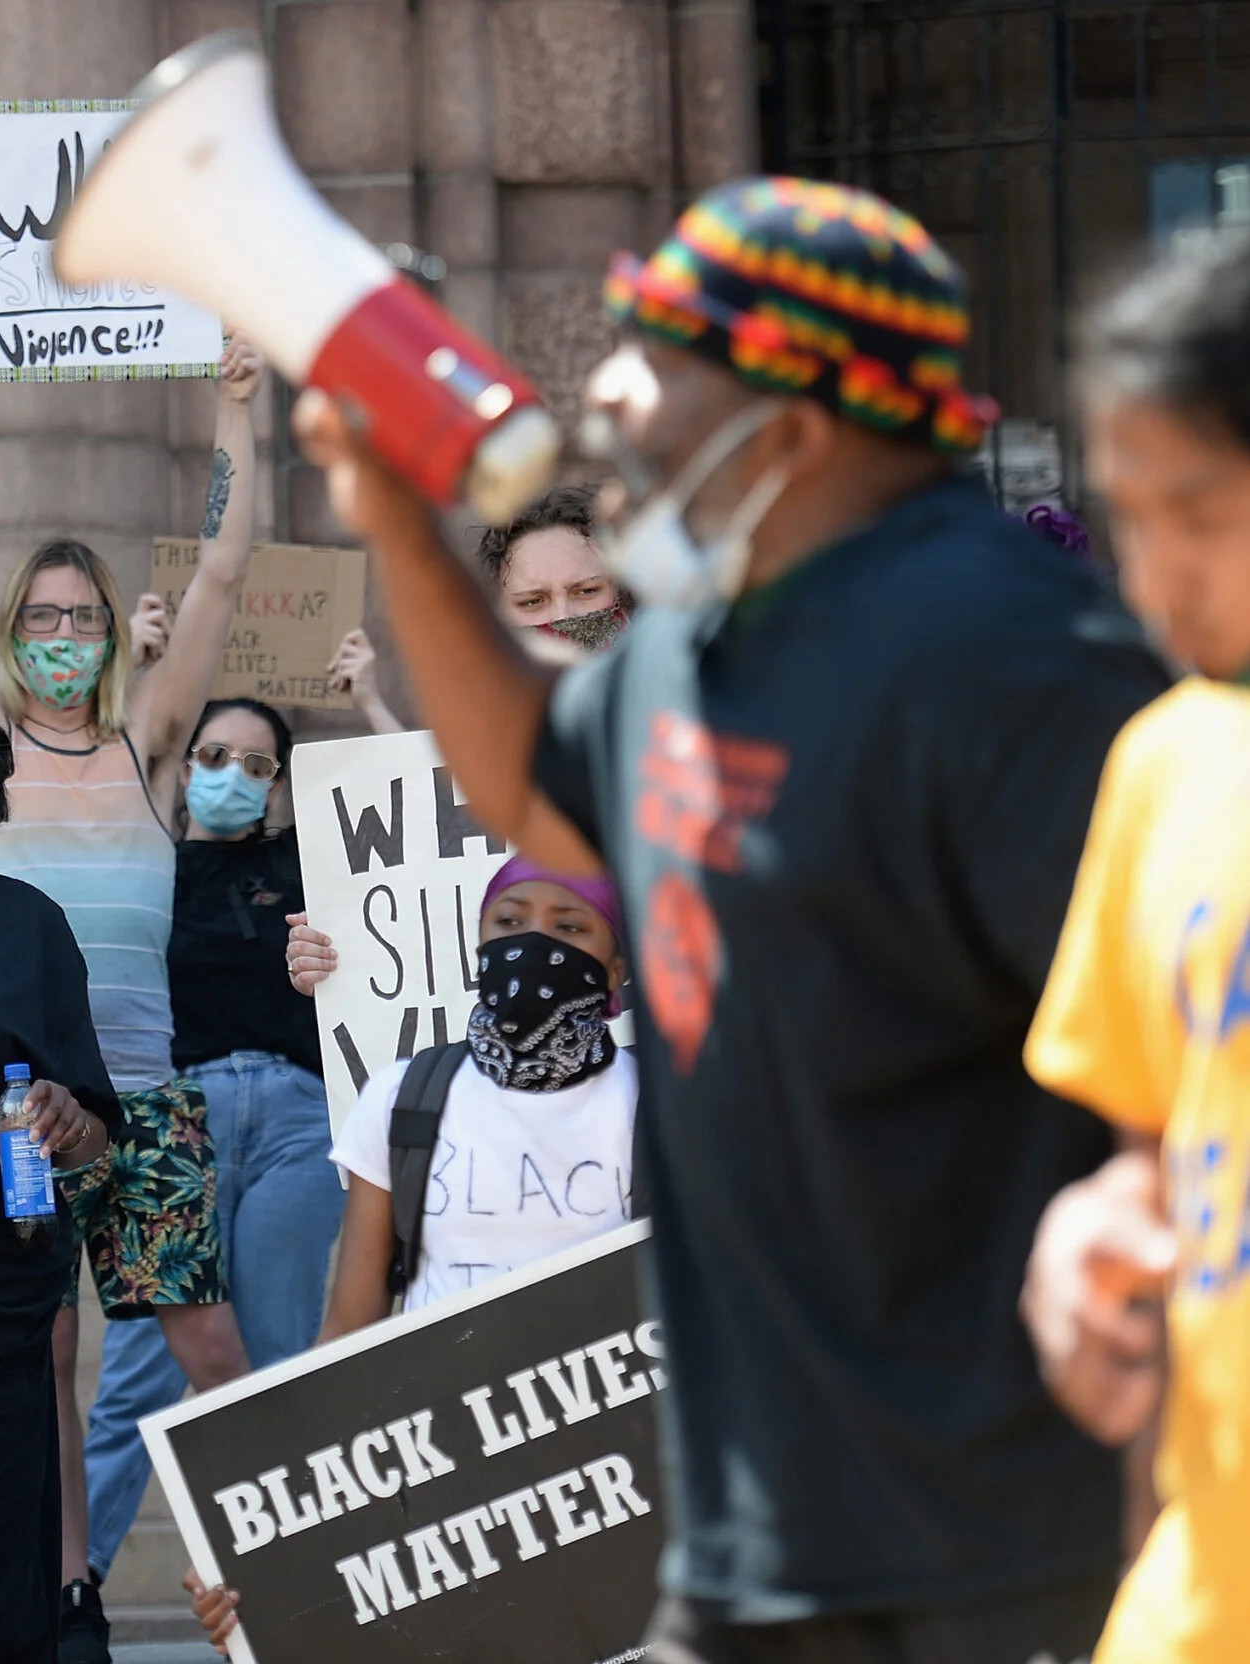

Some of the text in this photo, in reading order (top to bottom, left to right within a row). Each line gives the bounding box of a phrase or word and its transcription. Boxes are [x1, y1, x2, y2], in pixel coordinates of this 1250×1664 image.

[213, 1319, 668, 1556] BLACK LIVES
[334, 1453, 651, 1626] MATTER
